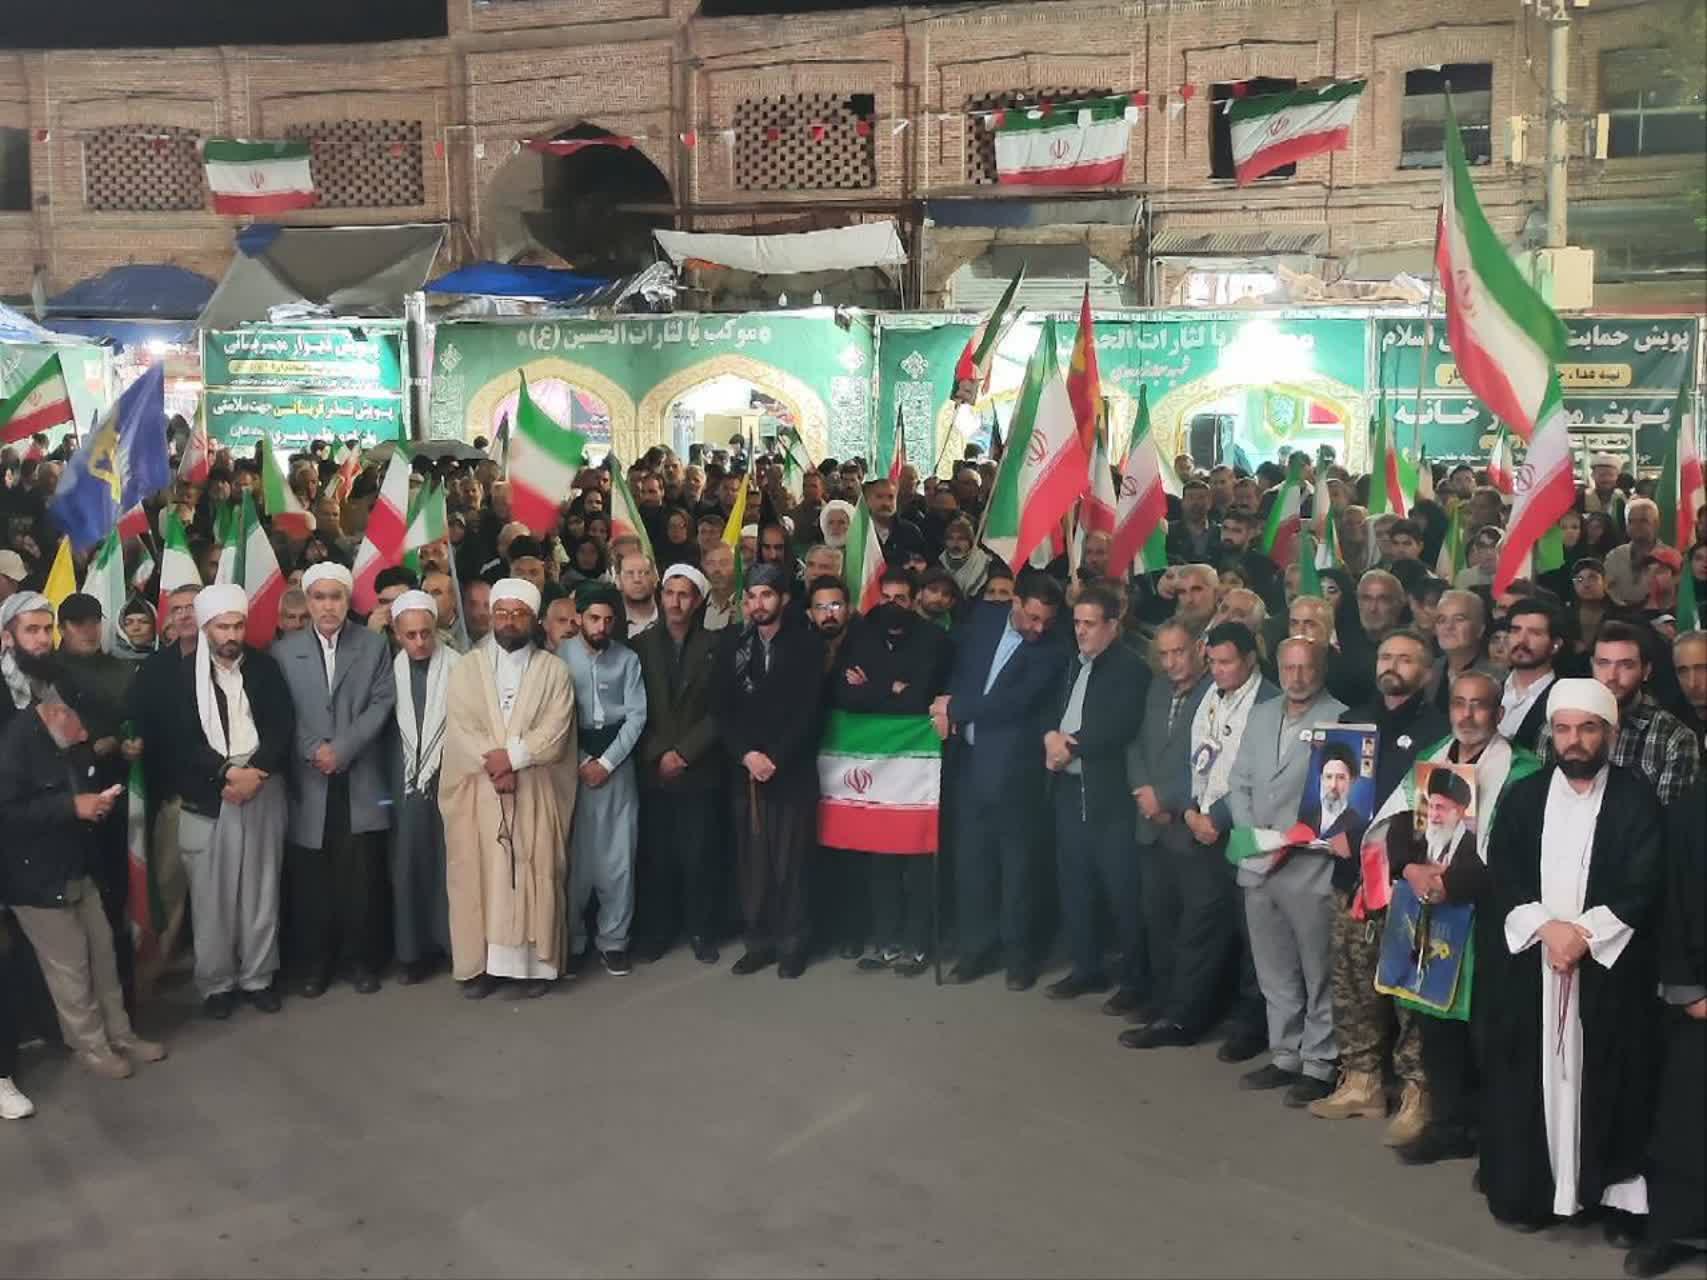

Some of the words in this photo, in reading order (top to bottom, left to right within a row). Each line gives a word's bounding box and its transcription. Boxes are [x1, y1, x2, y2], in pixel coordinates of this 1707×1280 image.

[529, 323, 560, 351] (ع)
[563, 323, 626, 350] الحسین
[687, 319, 701, 349] یا
[703, 319, 760, 350] موکب
[1382, 324, 1433, 351] اسلام
[1567, 325, 1629, 348] حمایت
[1634, 325, 1689, 352] پویش
[354, 400, 394, 424] پویش
